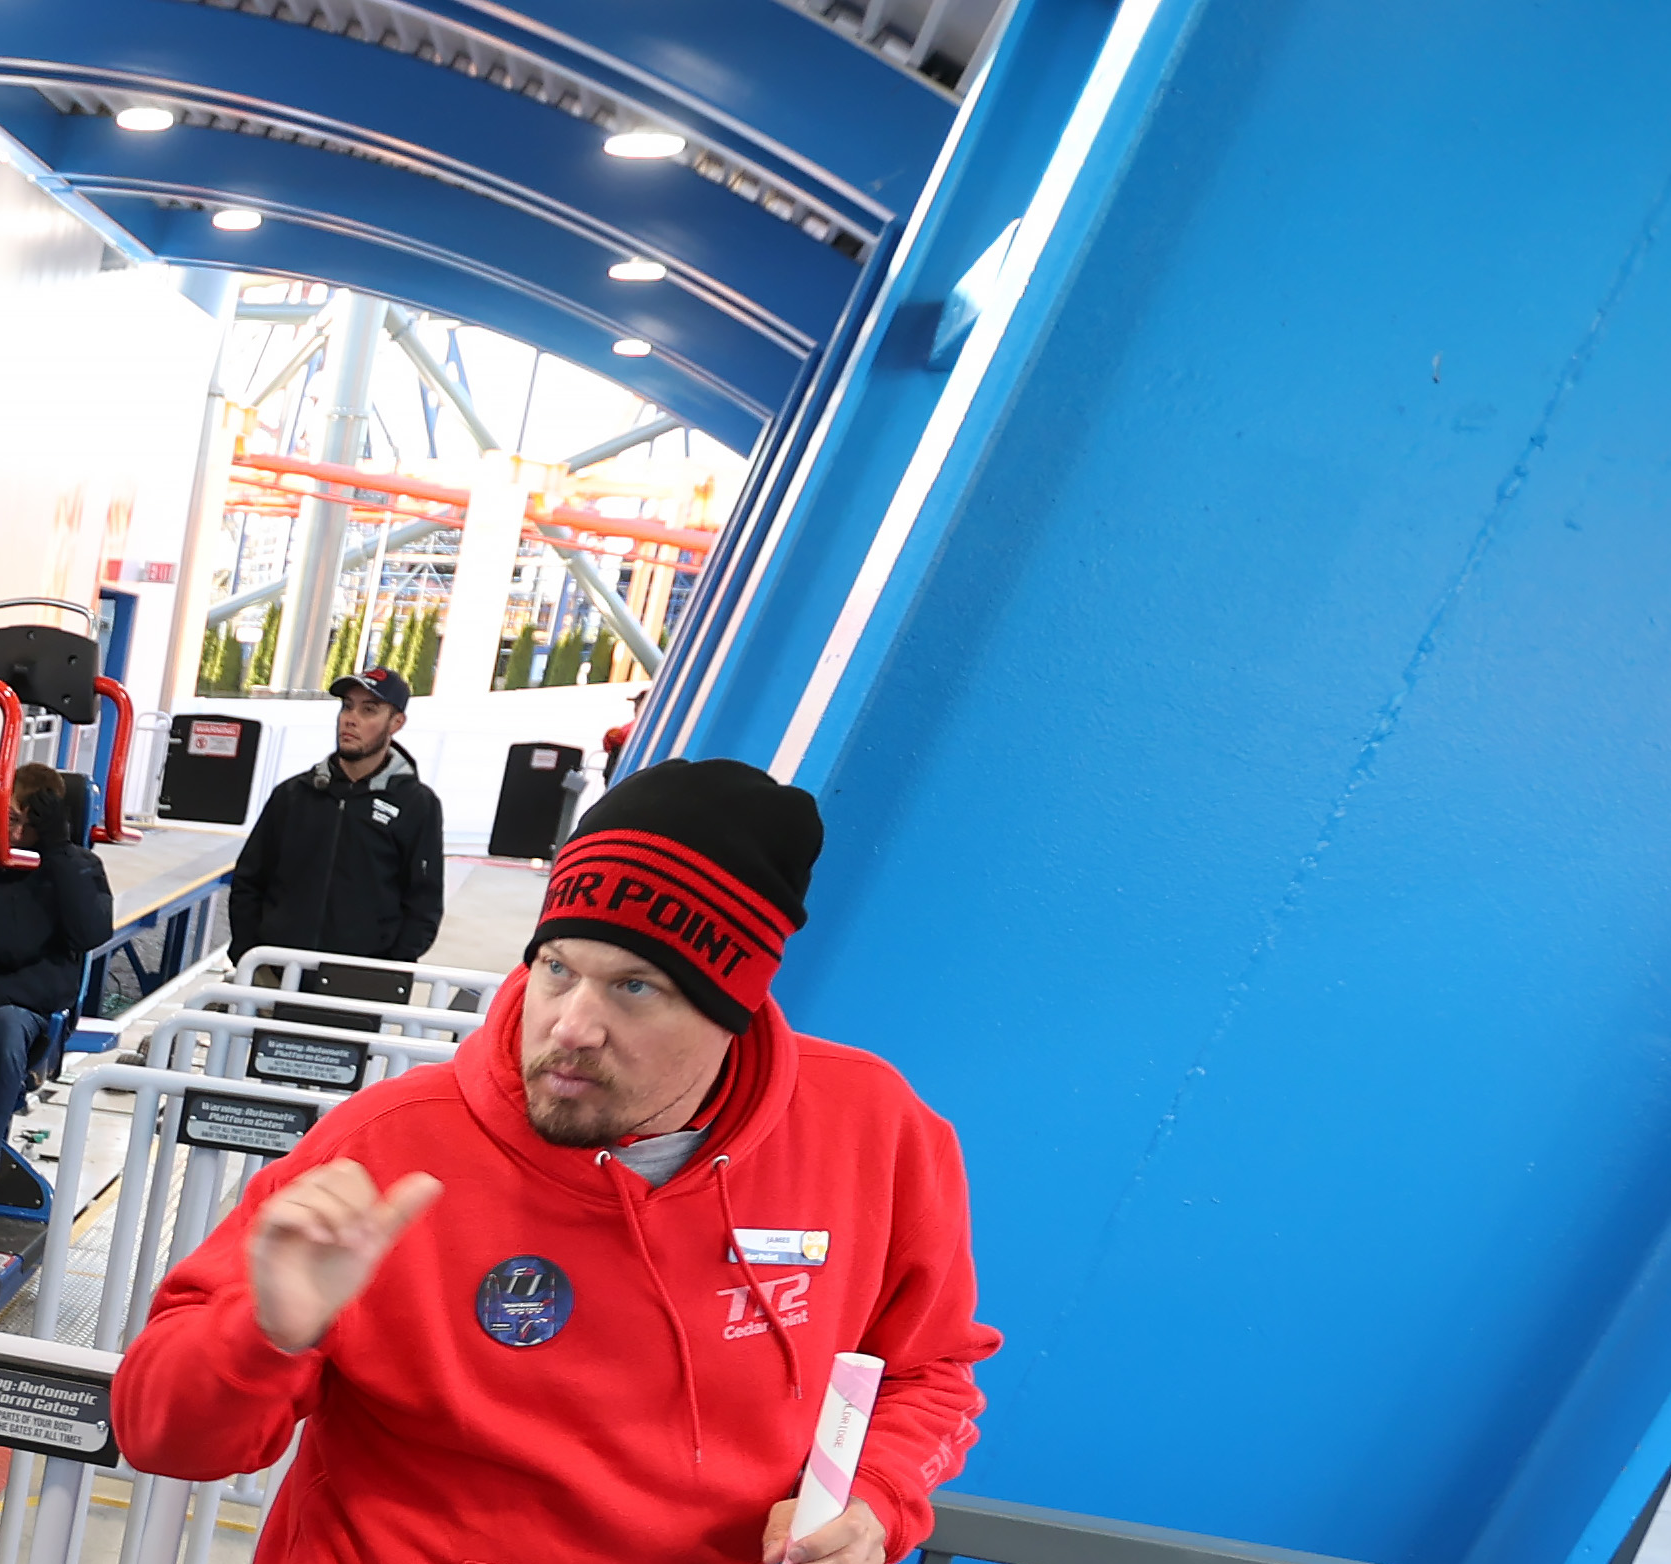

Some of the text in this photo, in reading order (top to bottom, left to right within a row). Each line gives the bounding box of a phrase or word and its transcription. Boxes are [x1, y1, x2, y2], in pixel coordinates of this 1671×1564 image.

[607, 876, 752, 978] POINT
[723, 1321, 769, 1340] Cedar
[17, 1380, 98, 1406] Automatic
[32, 1397, 80, 1417] Gates
[21, 1414, 30, 1424] OF
[34, 1417, 52, 1428] YOUR
[54, 1420, 73, 1432] BODY
[9, 1423, 32, 1436] GATES
[34, 1427, 43, 1437] AT
[44, 1430, 57, 1440] ALL
[60, 1433, 82, 1445] TIMES
